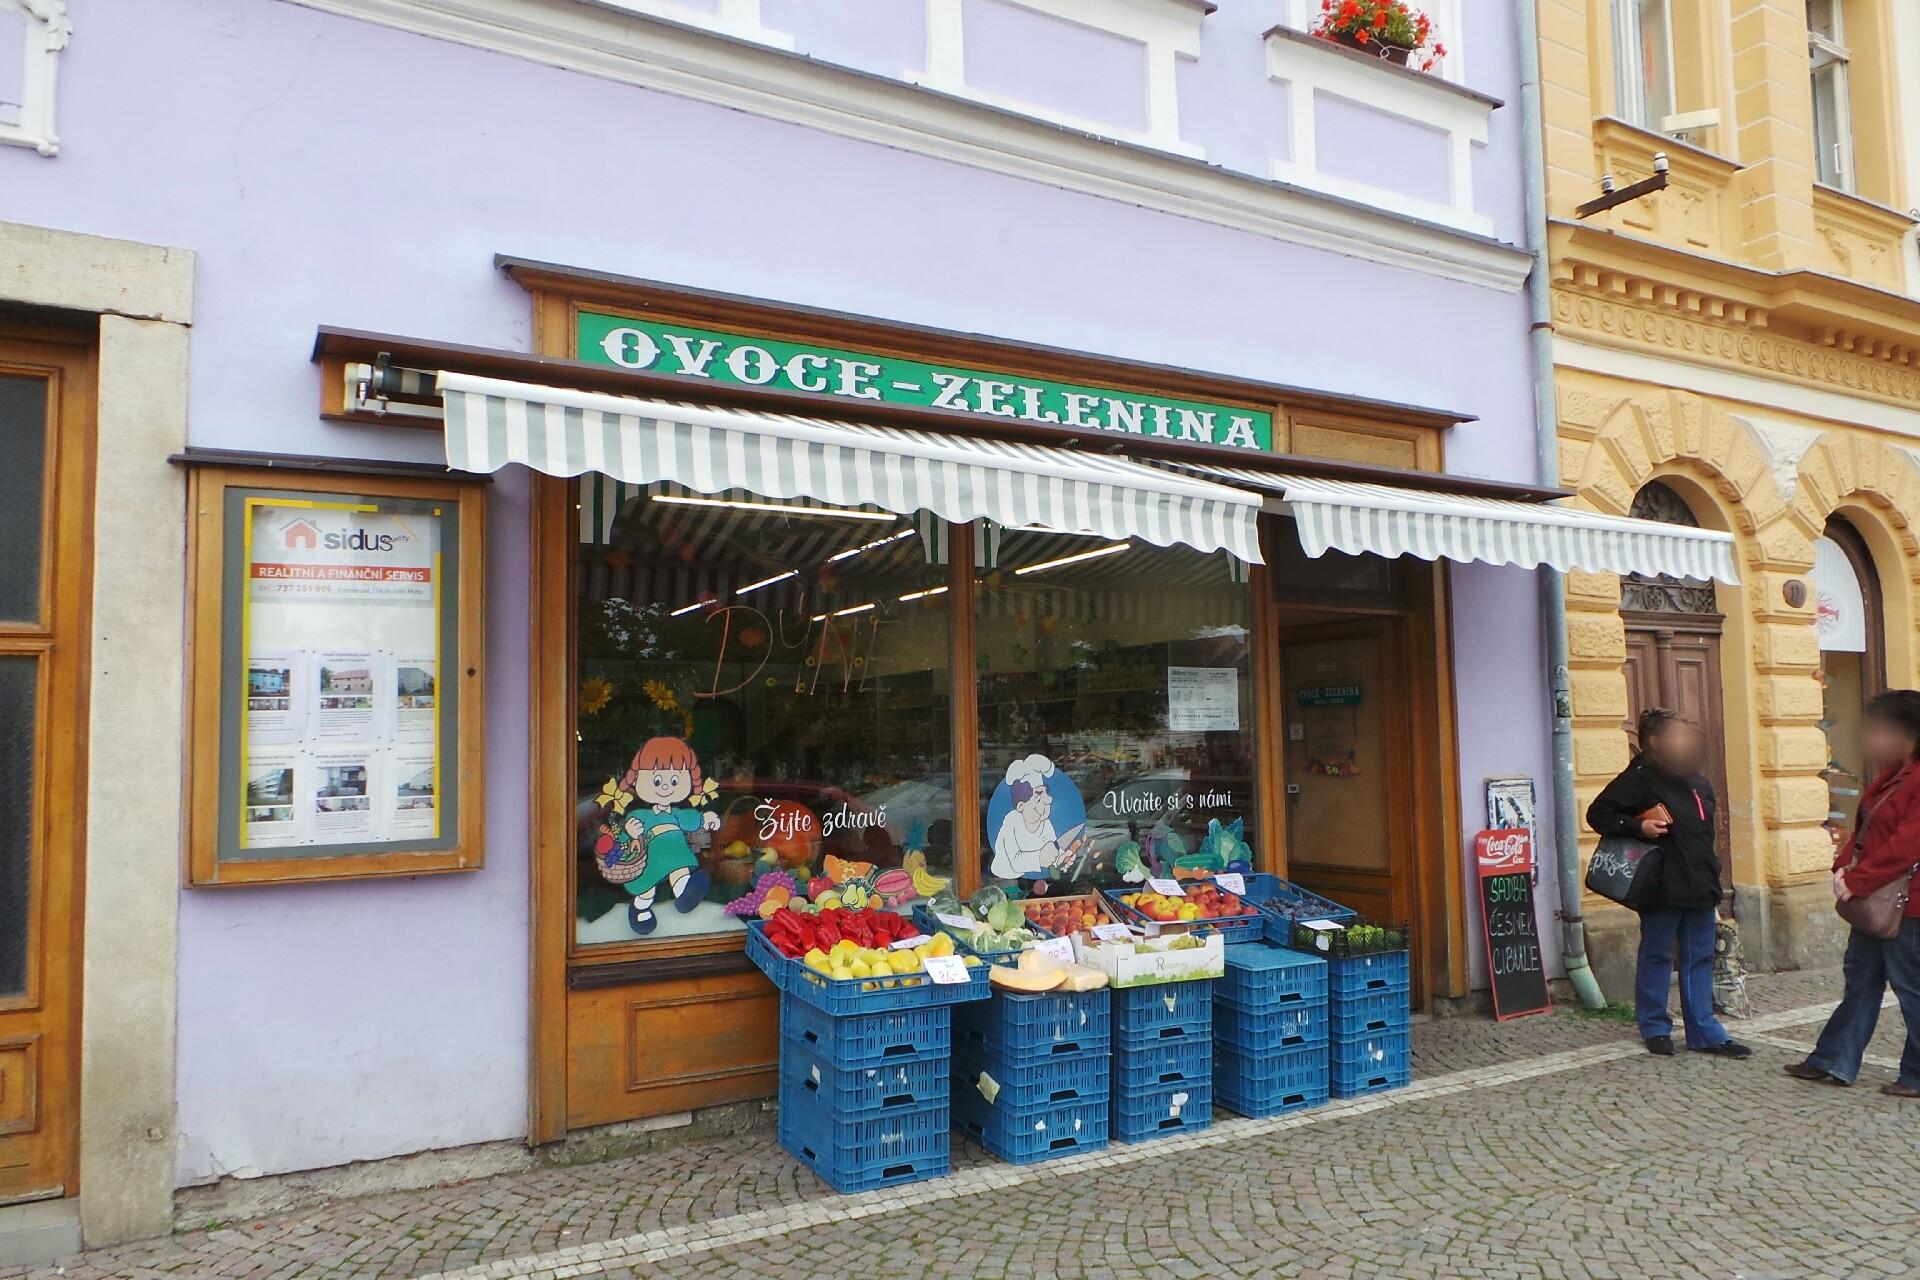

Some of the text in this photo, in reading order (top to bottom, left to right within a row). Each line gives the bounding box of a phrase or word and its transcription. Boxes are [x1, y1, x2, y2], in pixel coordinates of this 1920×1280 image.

[323, 528, 393, 552] sidus
[258, 565, 425, 582] REALITNÍ A FINANČNÍ SERVIS
[1103, 788, 1233, 815] Uvařte si s námi
[753, 797, 887, 841] Žijte zdravě
[1486, 834, 1523, 857] Coca-Cola
[1489, 874, 1528, 903] SADBA
[1492, 945, 1540, 975] CIBULE
